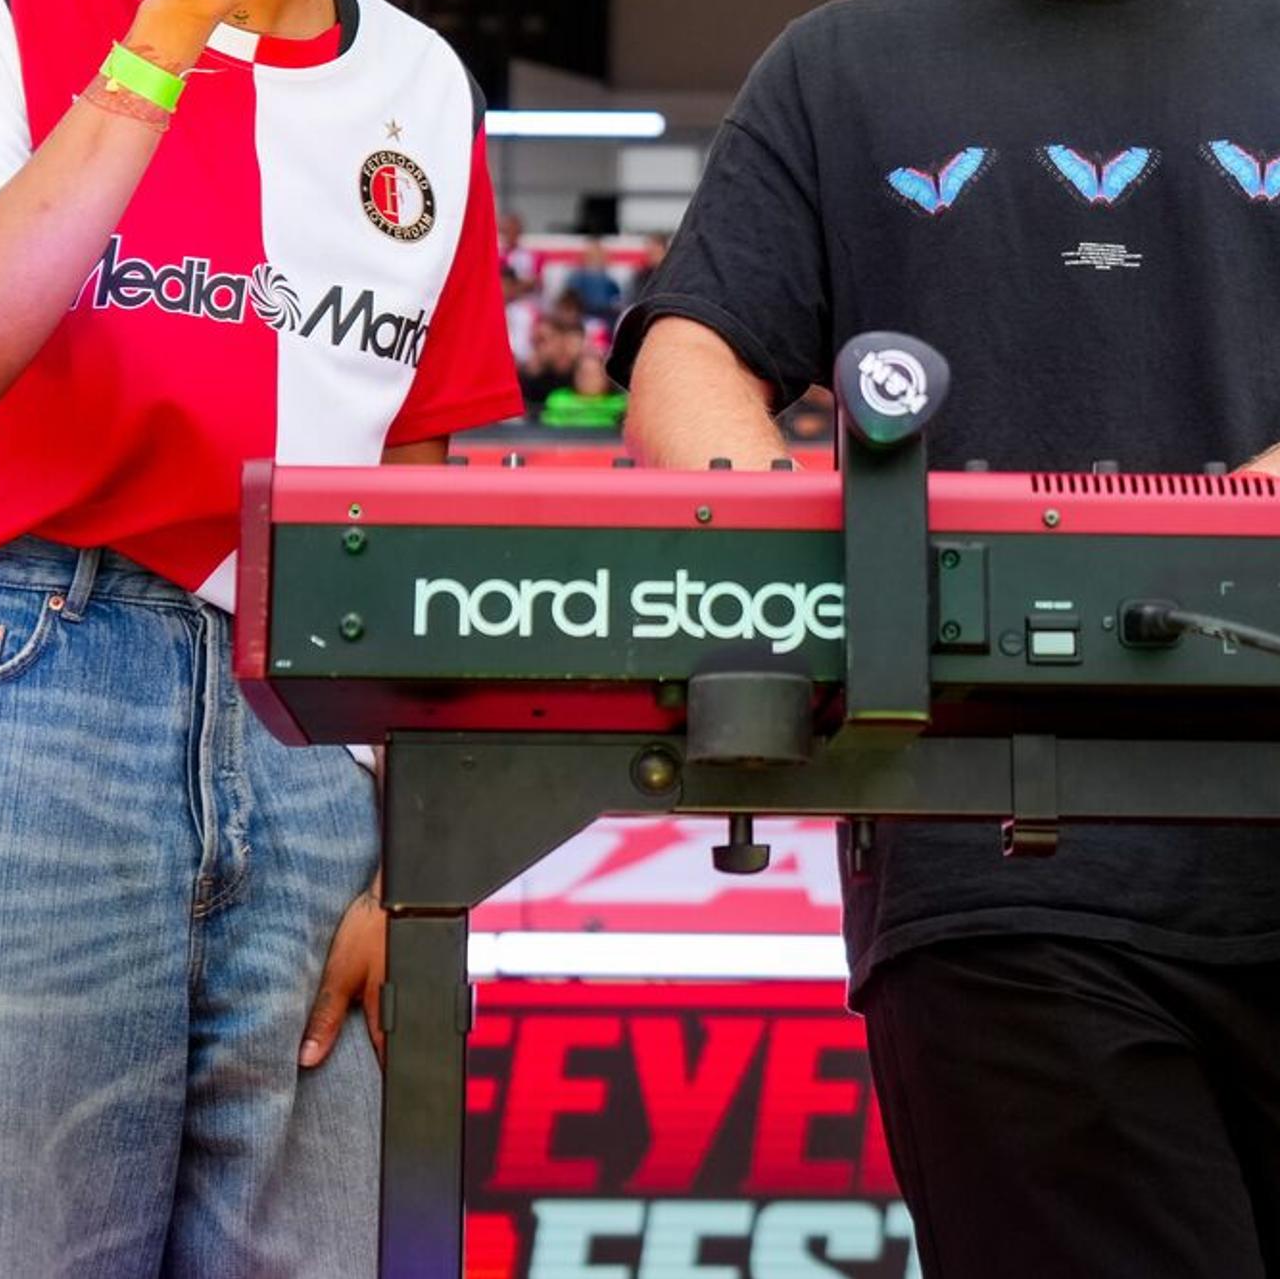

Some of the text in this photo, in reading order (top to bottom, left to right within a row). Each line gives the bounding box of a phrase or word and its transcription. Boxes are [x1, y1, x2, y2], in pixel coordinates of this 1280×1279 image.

[298, 283, 429, 369] Mark
[858, 351, 928, 415] K&M
[413, 569, 845, 655] nord stage
